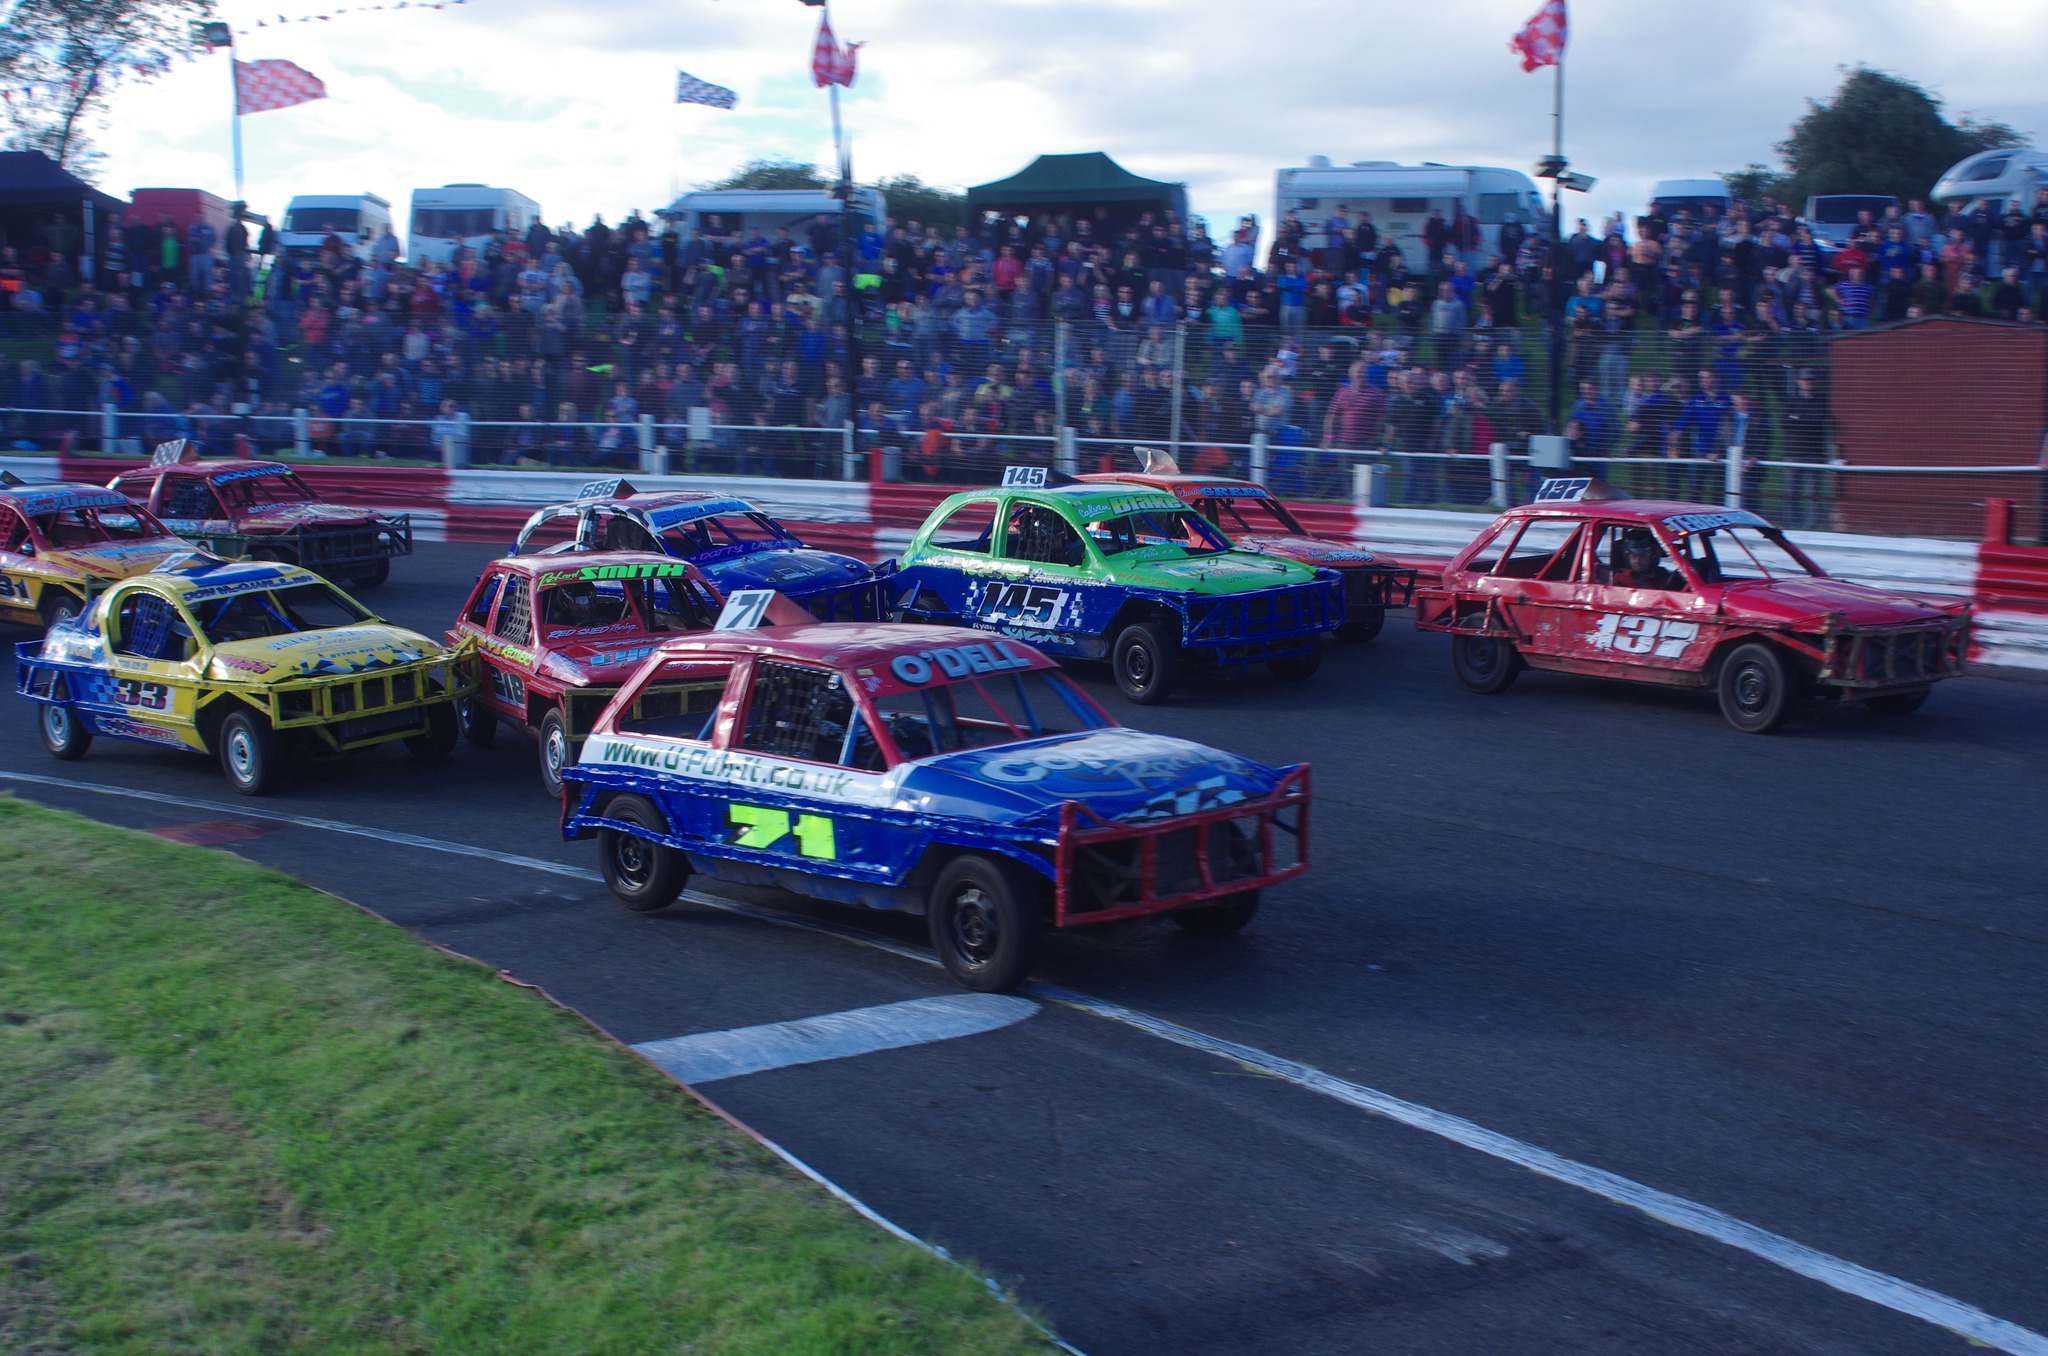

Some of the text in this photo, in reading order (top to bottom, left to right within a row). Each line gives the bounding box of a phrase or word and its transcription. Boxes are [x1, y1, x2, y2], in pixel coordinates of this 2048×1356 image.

[1007, 468, 1044, 485] 145
[578, 480, 619, 499] 686
[1538, 480, 1588, 500] 137
[1108, 494, 1184, 515] Blake
[579, 563, 686, 581] SMITH
[726, 593, 771, 628] 71
[976, 581, 1062, 623] 145
[547, 629, 576, 640] RED
[575, 625, 609, 636] SHED
[972, 622, 996, 631] Ryan
[1588, 613, 1699, 659] 137
[890, 641, 1034, 685] O'DELL
[116, 678, 169, 710] 33
[726, 803, 836, 860] 71
